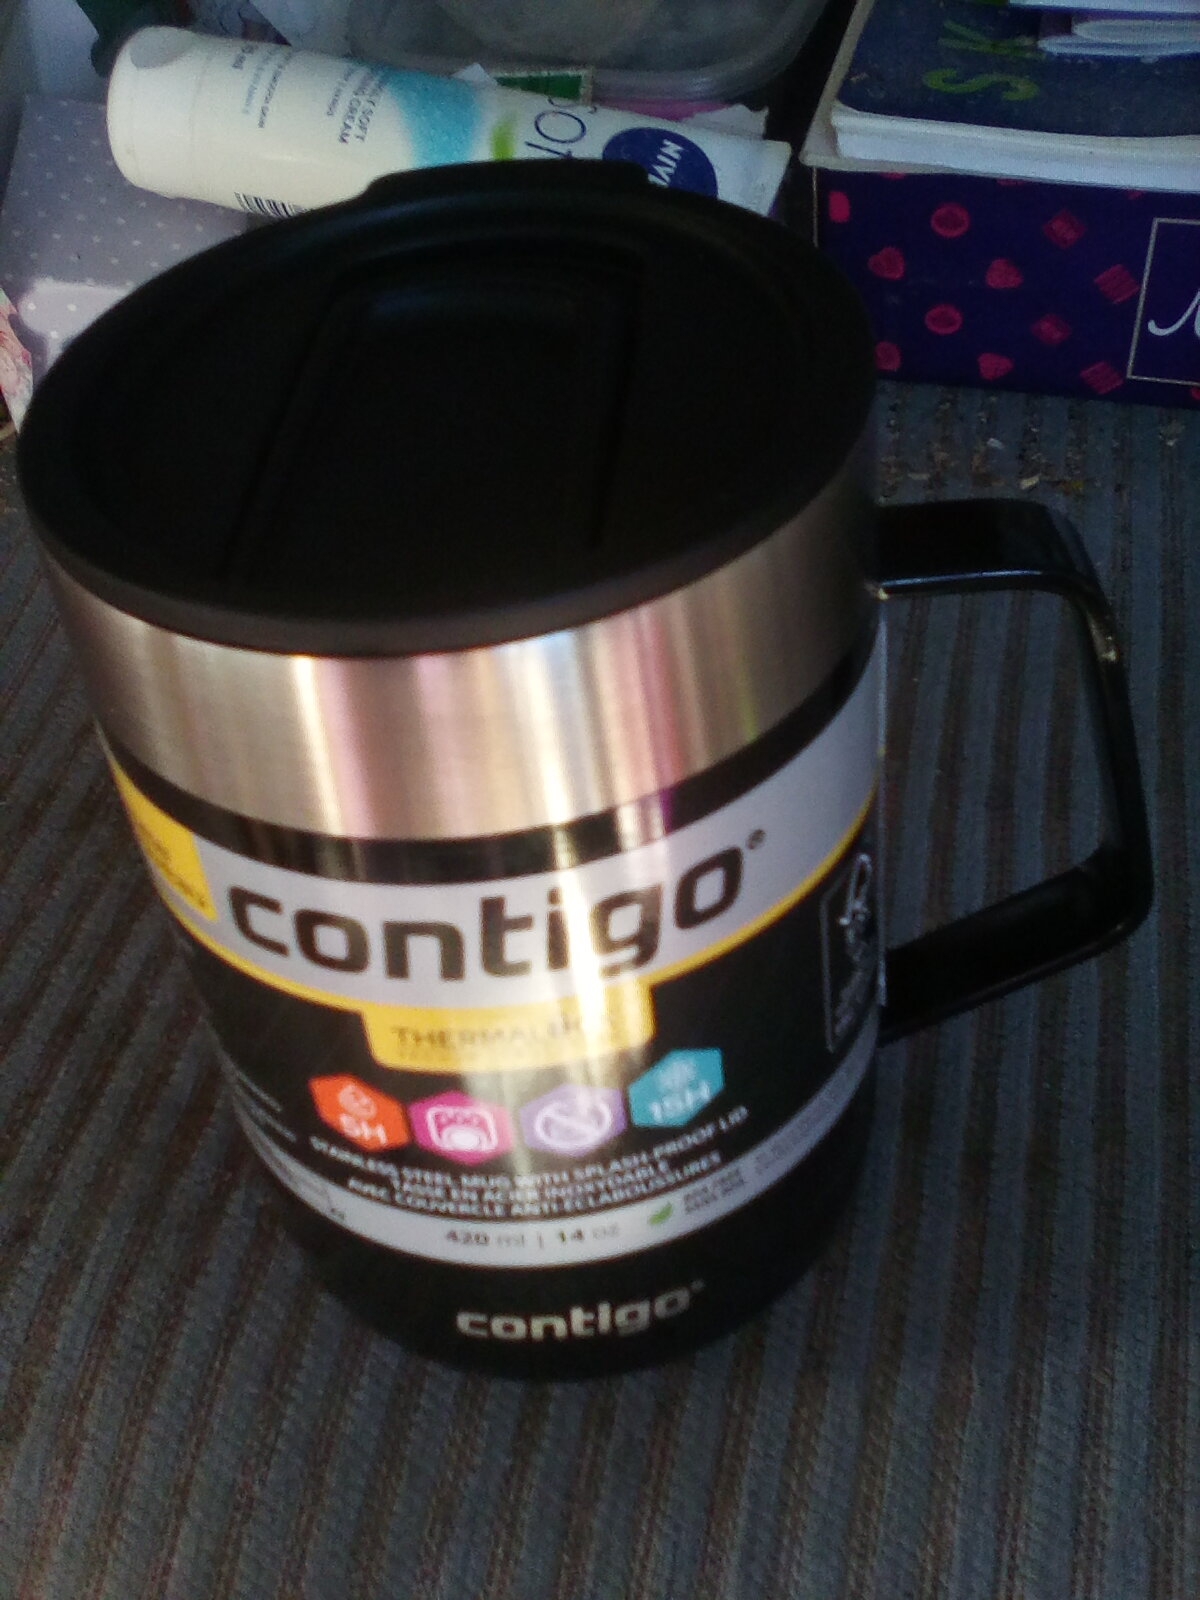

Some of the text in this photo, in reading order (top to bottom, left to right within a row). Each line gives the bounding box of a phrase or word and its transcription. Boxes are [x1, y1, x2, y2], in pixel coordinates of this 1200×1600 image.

[228, 845, 744, 983] contigo
[446, 1228, 489, 1247] 420
[558, 1227, 585, 1244] 14
[456, 1286, 691, 1342] contigo
